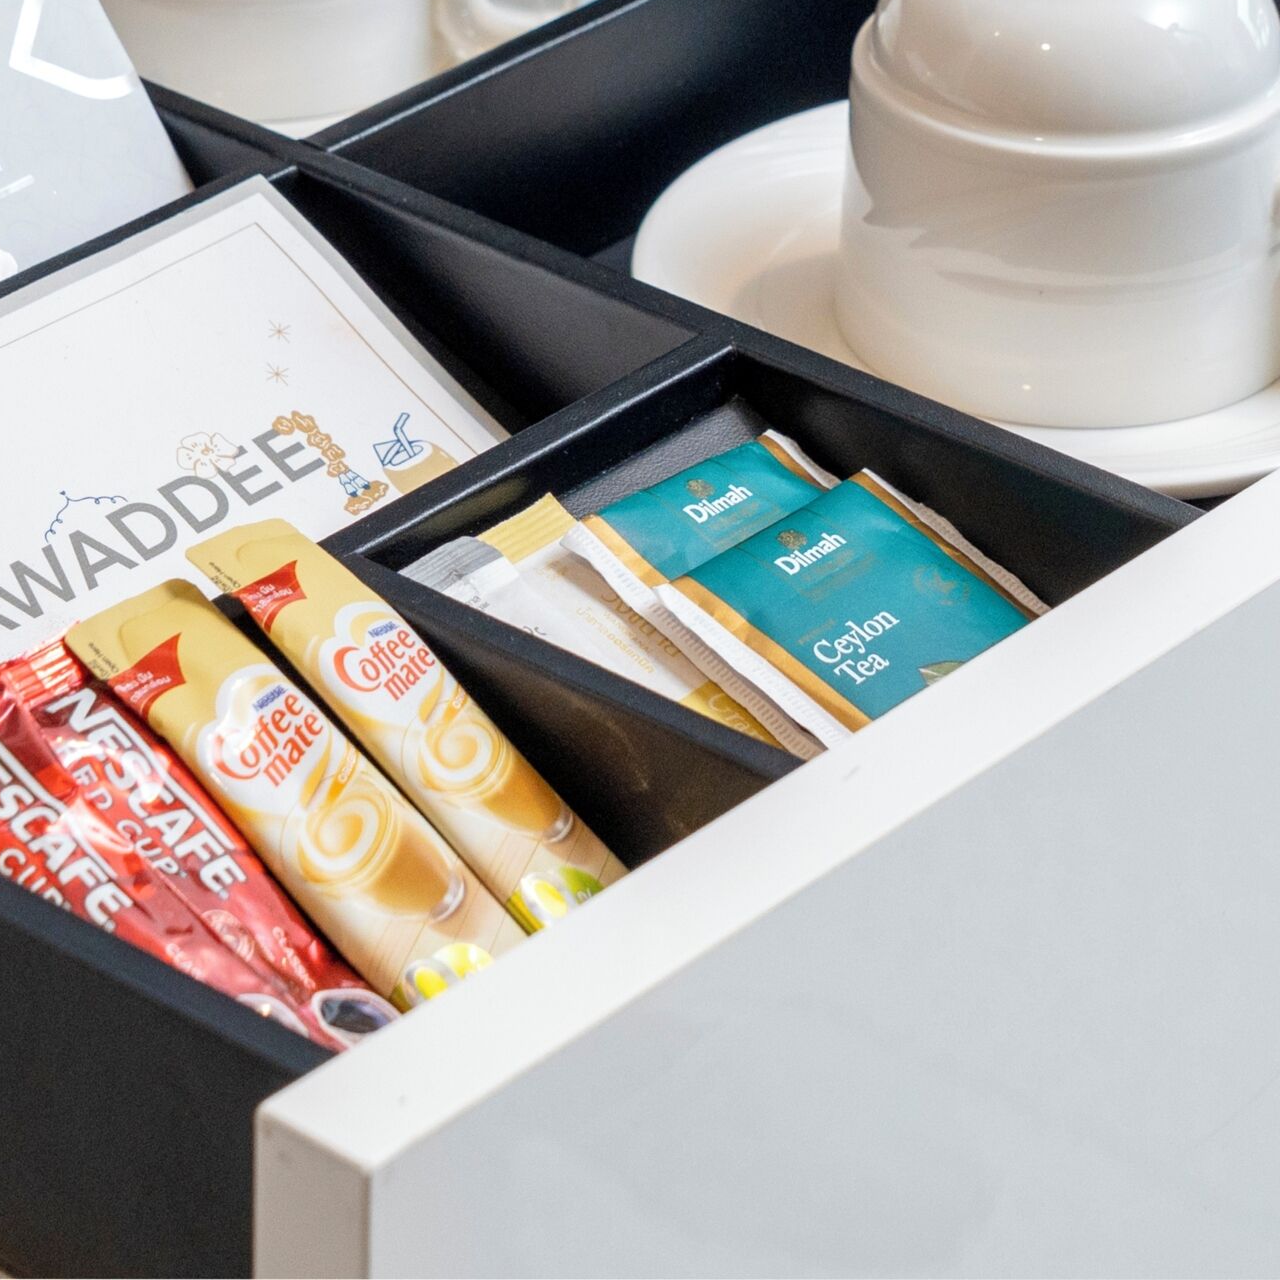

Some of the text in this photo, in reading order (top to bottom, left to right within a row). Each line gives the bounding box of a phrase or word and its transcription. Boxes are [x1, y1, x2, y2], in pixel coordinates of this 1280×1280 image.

[682, 484, 754, 524] Dilmah
[773, 532, 847, 576] Dilmah
[333, 628, 416, 693] Coffee
[812, 609, 901, 664] Ceylon
[383, 646, 436, 702] mate
[833, 653, 891, 686] Tea
[214, 693, 304, 780] Coffee
[263, 712, 323, 788] mate
[116, 818, 181, 876] CUP
